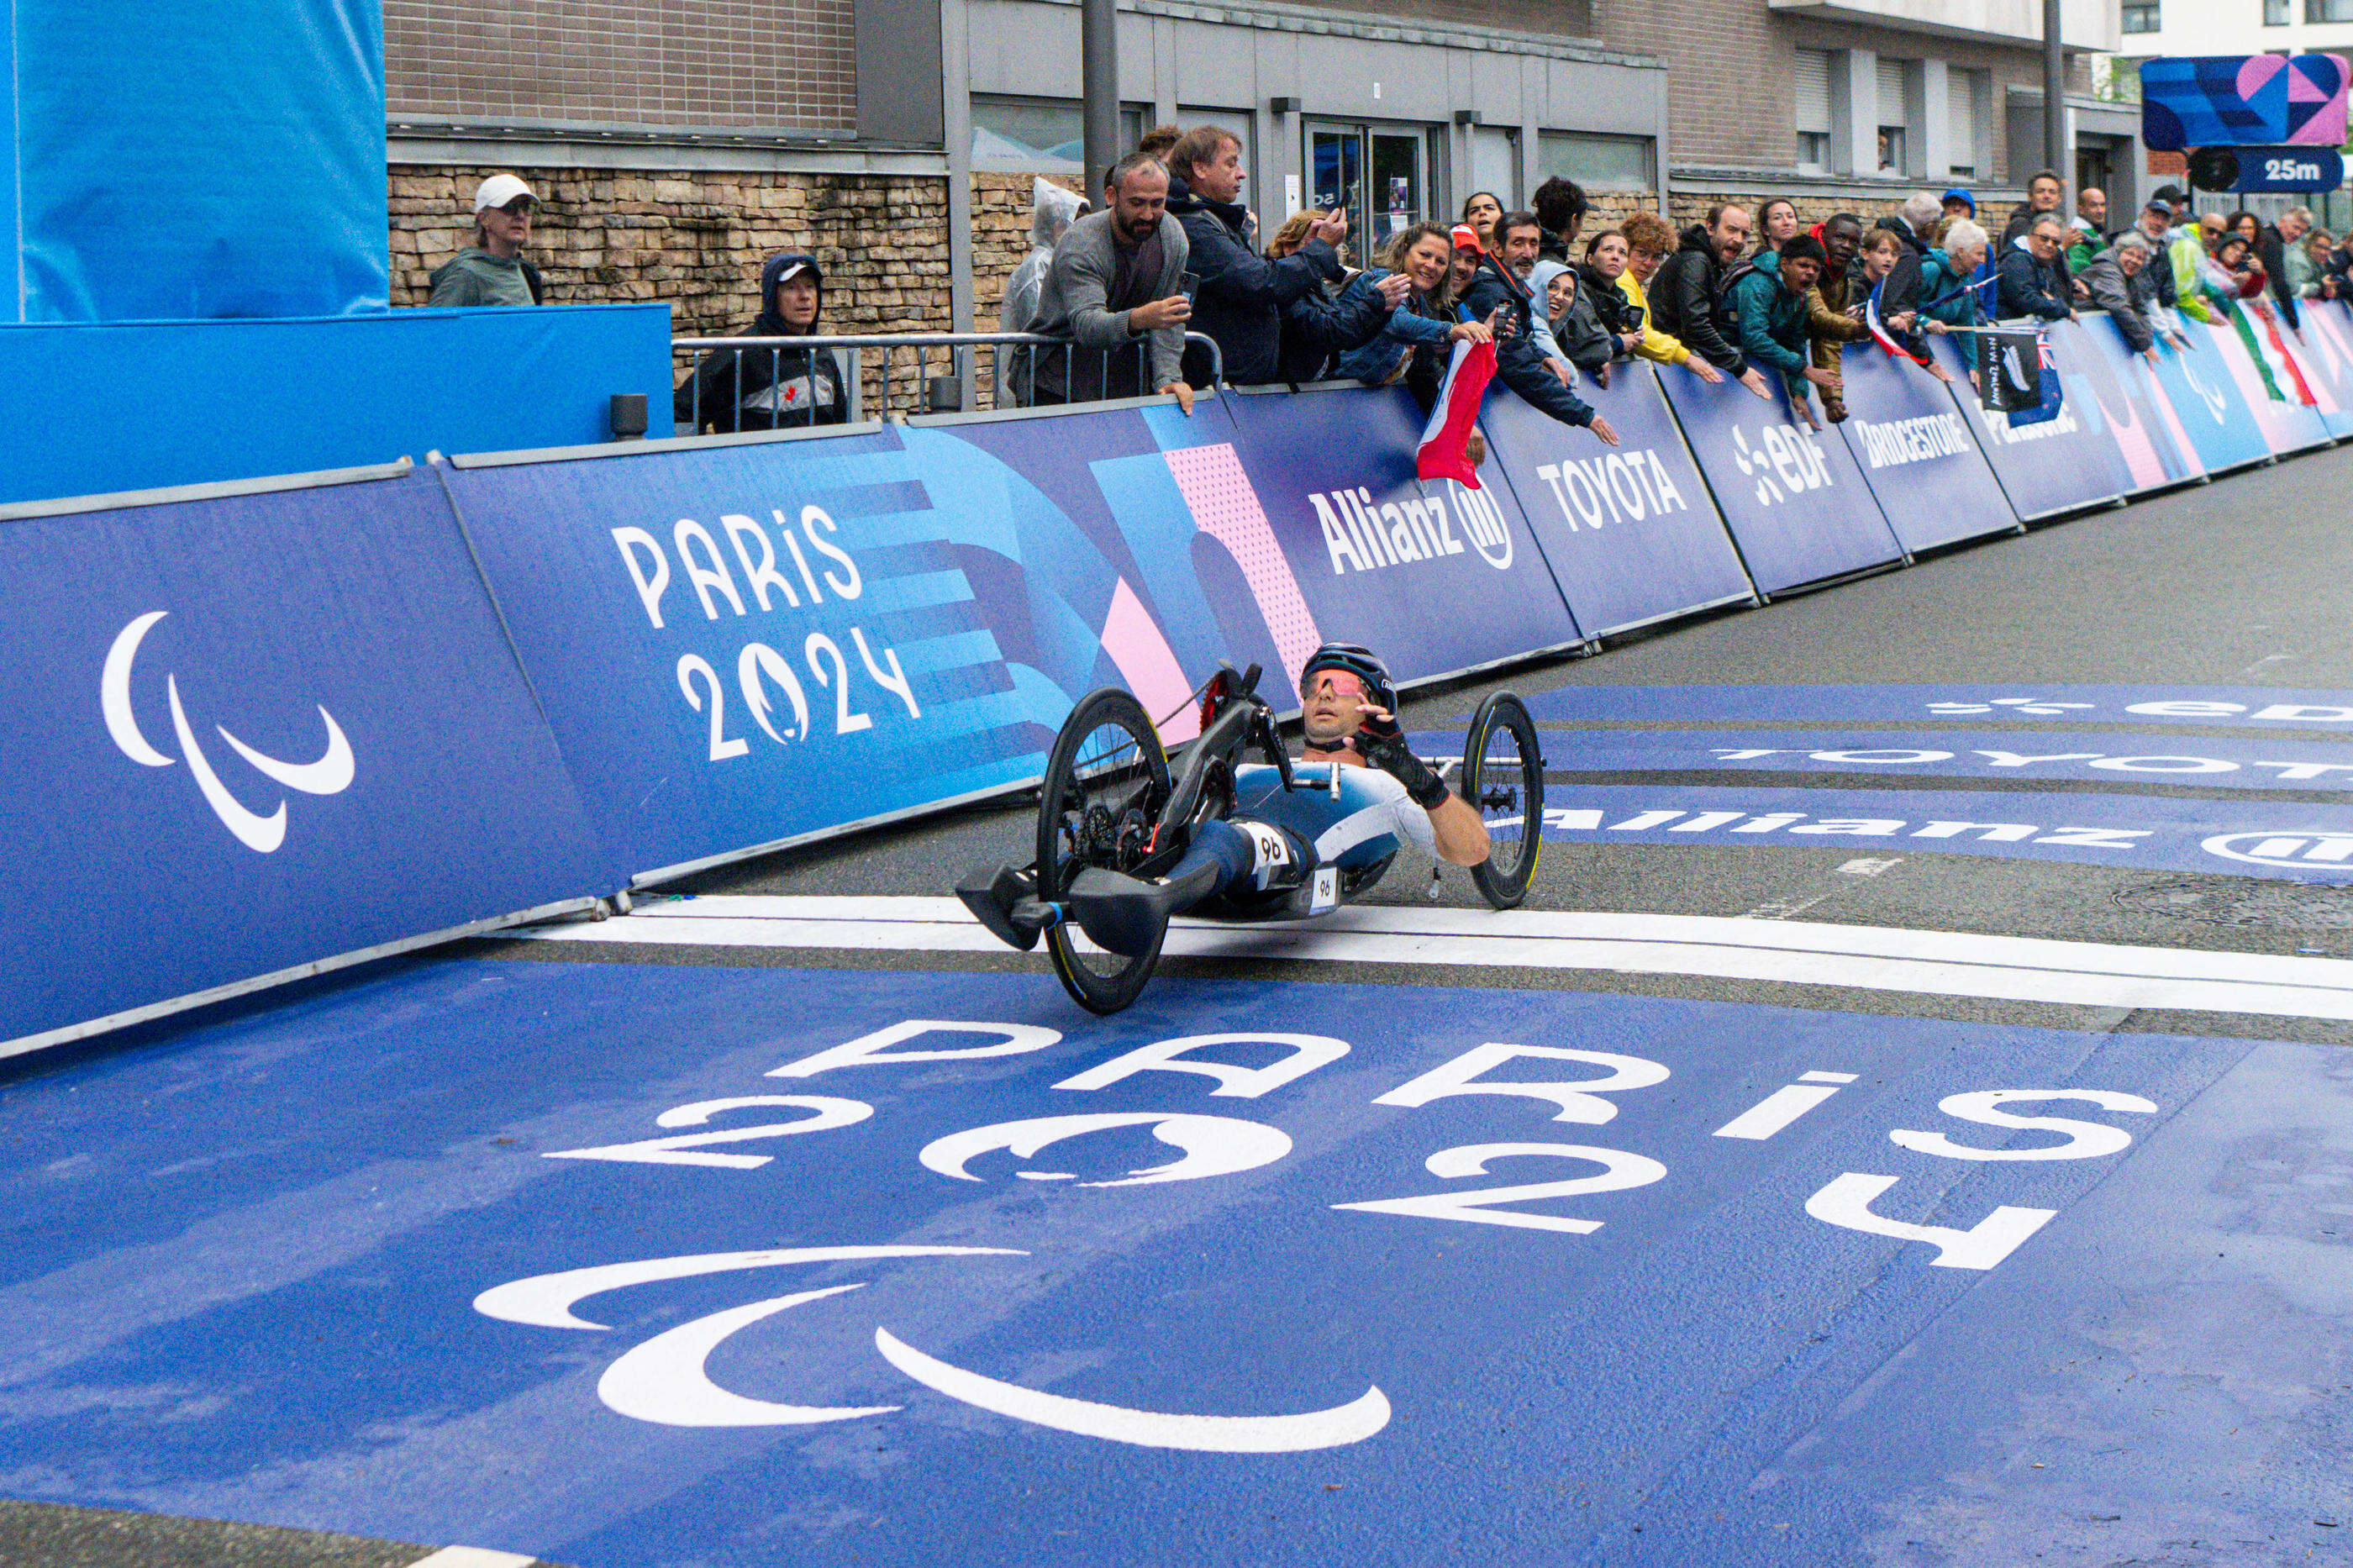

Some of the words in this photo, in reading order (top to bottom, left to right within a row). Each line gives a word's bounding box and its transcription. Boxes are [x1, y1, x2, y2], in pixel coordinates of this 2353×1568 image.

[2265, 159, 2319, 181] 25m
[1855, 412, 1971, 468] BRIDGESTONE
[1536, 449, 1688, 532] TOYOTA
[1308, 485, 1466, 575] Allianz
[676, 627, 921, 762] 2024
[1718, 748, 2353, 781] TOYOT
[1261, 837, 1281, 861] 96
[1483, 808, 2154, 849] Allianz
[1319, 879, 1330, 897] 96
[541, 1095, 2058, 1271] 2024
